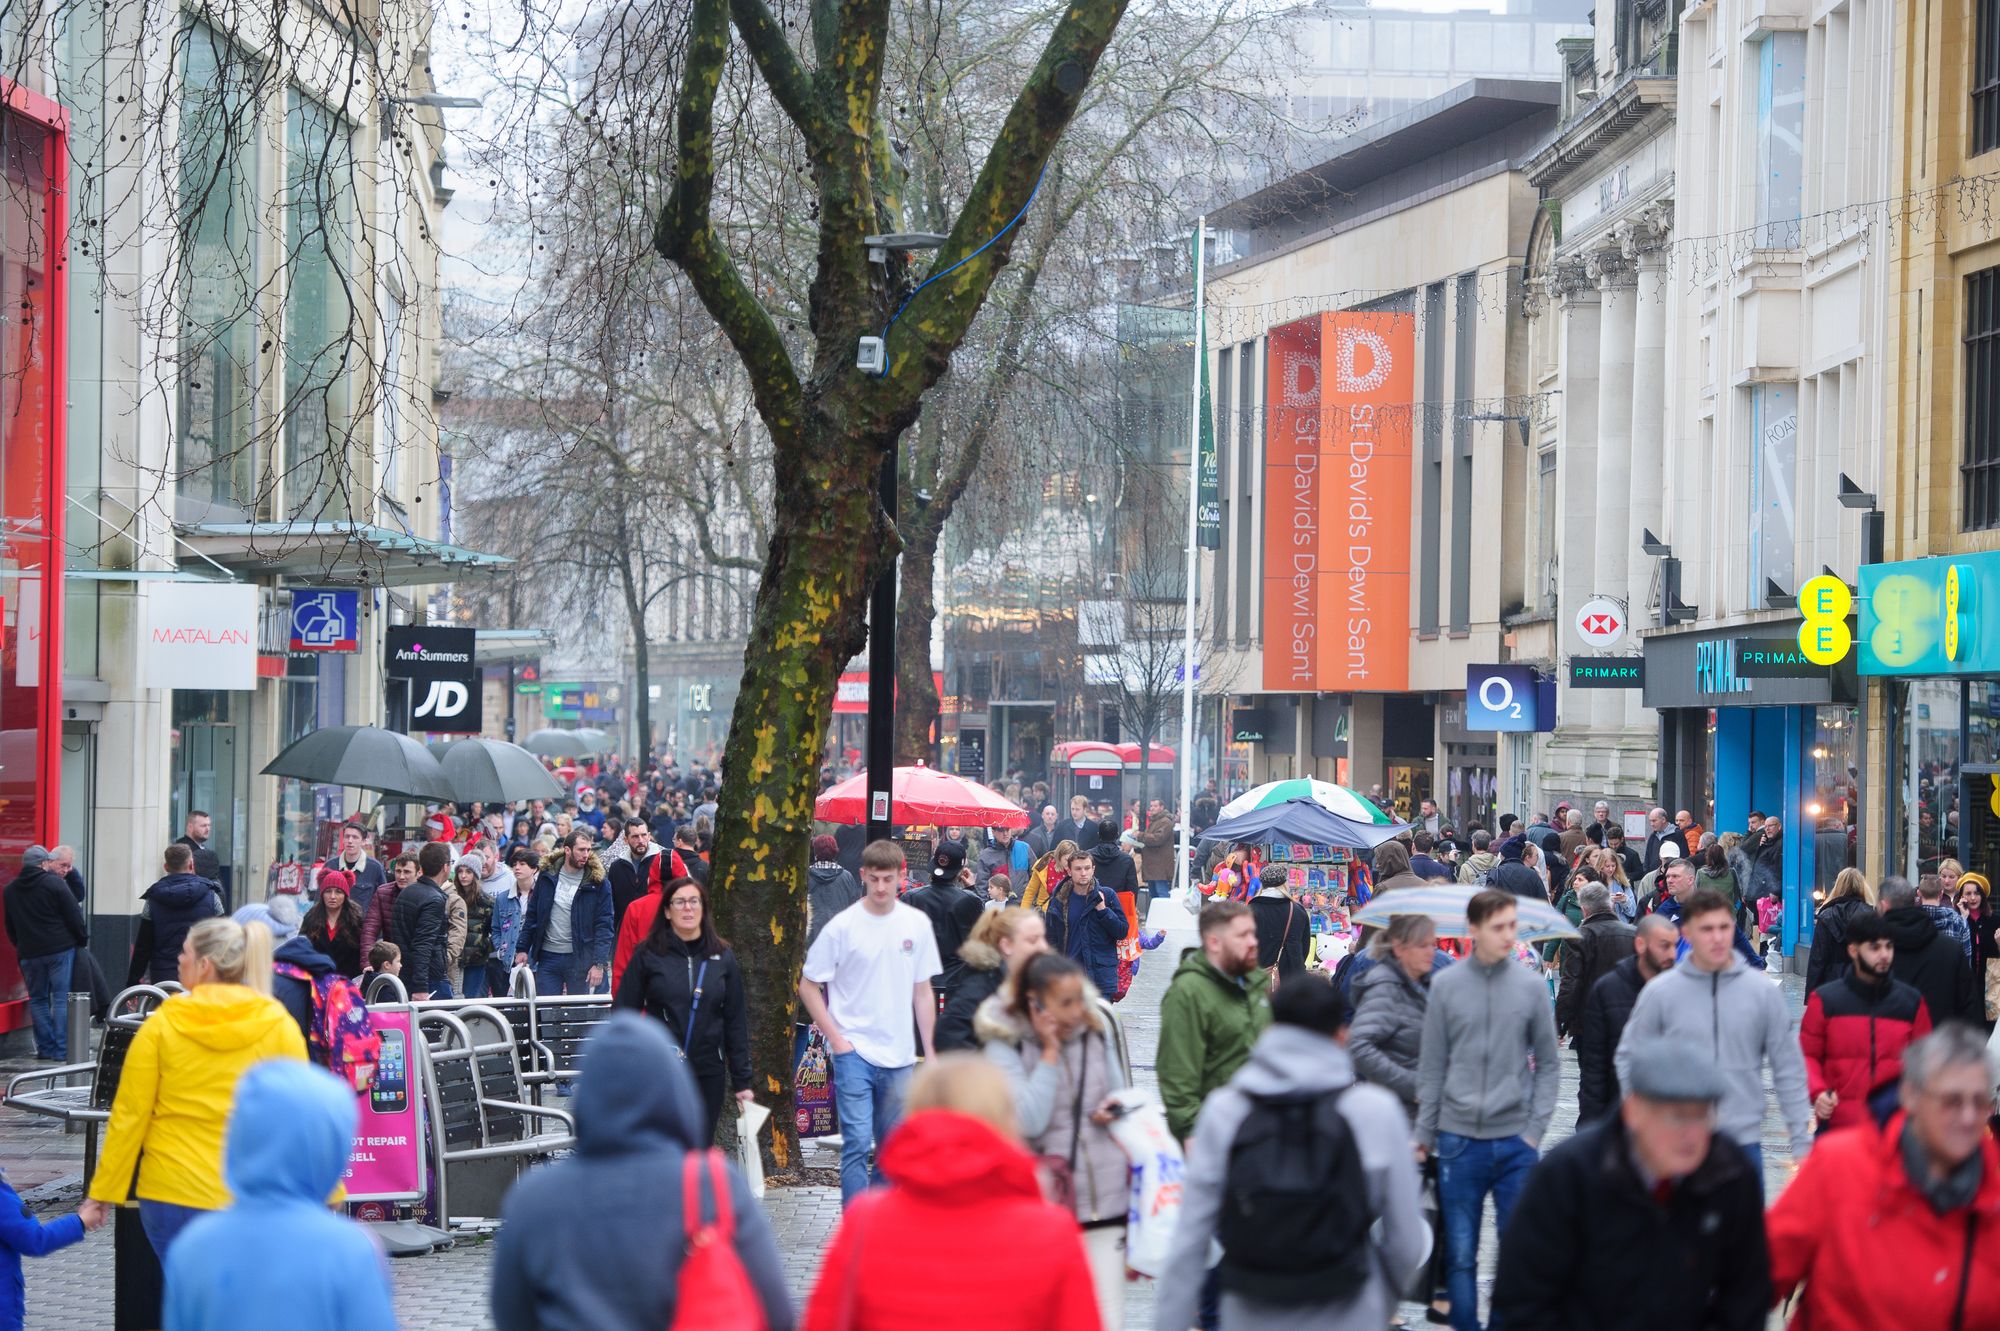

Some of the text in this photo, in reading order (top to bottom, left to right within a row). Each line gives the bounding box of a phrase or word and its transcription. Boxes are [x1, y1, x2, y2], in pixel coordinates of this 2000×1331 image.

[1336, 327, 1392, 393] D
[1283, 351, 1321, 407] D
[1291, 417, 1317, 681] St David's Dewi Sant
[1347, 404, 1374, 680] St David's Dewi Sant
[152, 628, 248, 644] MATALAN
[395, 649, 469, 662] Ann Summers
[1697, 636, 1752, 694] PRIMA
[1743, 652, 1808, 664] PRIMAR
[1576, 667, 1639, 679] PRIMARK
[414, 681, 469, 717] JD
[367, 1136, 407, 1146] REPAIR
[348, 1152, 376, 1162] SELL
